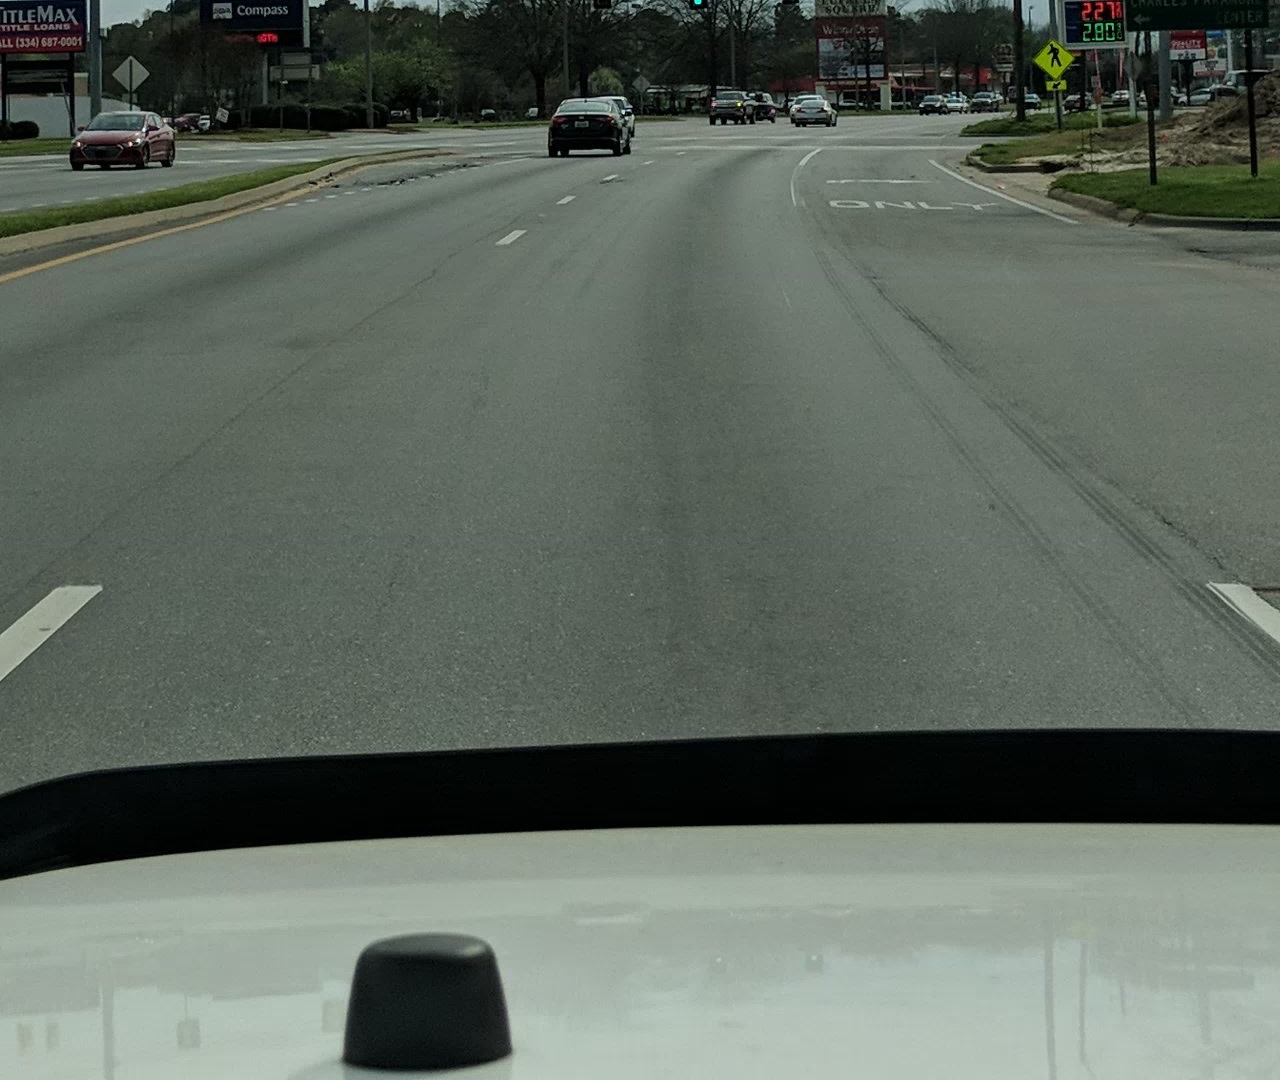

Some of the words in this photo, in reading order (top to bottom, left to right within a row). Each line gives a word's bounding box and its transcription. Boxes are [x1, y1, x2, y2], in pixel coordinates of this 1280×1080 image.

[237, 5, 289, 18] Compass
[1216, 9, 1264, 25] CENTER
[0, 24, 30, 32] TITLE
[34, 23, 71, 31] LOANS
[16, 36, 39, 49] (334)
[41, 36, 83, 48] 687-0001
[828, 199, 999, 211] ONLY
